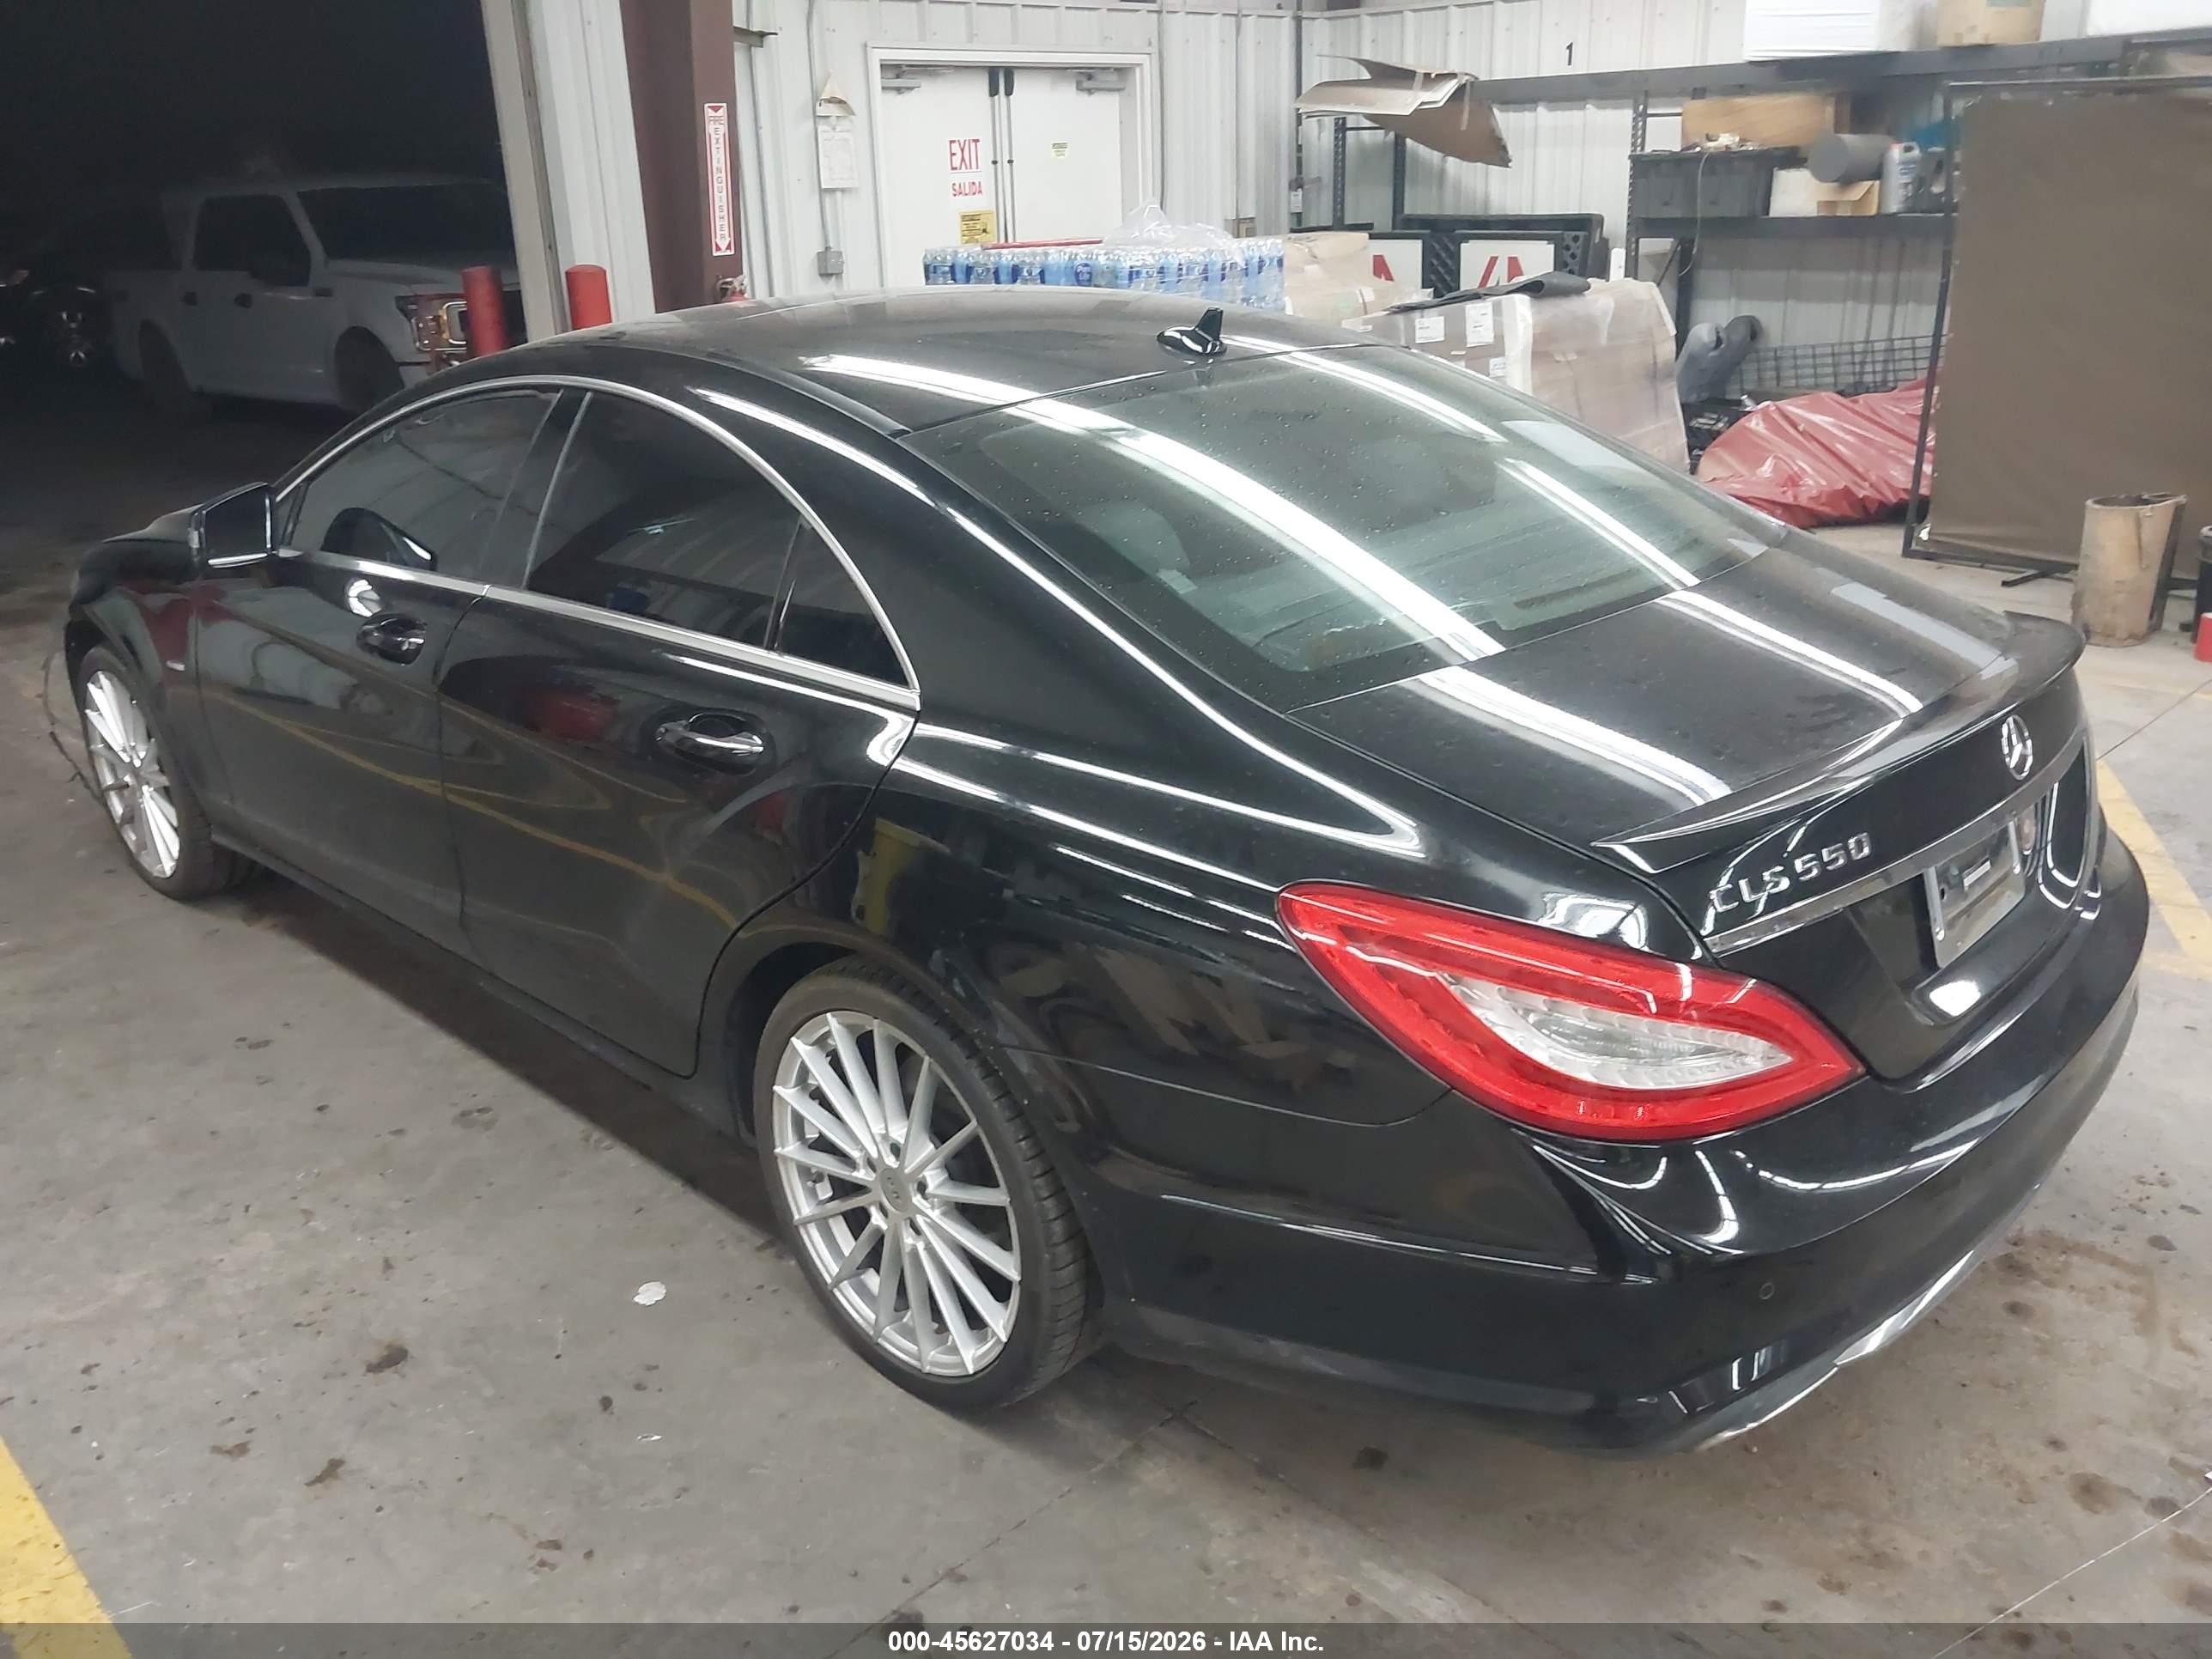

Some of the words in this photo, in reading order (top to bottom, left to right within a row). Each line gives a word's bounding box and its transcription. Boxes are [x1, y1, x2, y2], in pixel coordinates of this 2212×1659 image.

[1565, 41, 1574, 66] 1
[949, 138, 981, 170] EXIT
[714, 127, 726, 240] EXTINGUISHER
[951, 181, 983, 198] SALIDA
